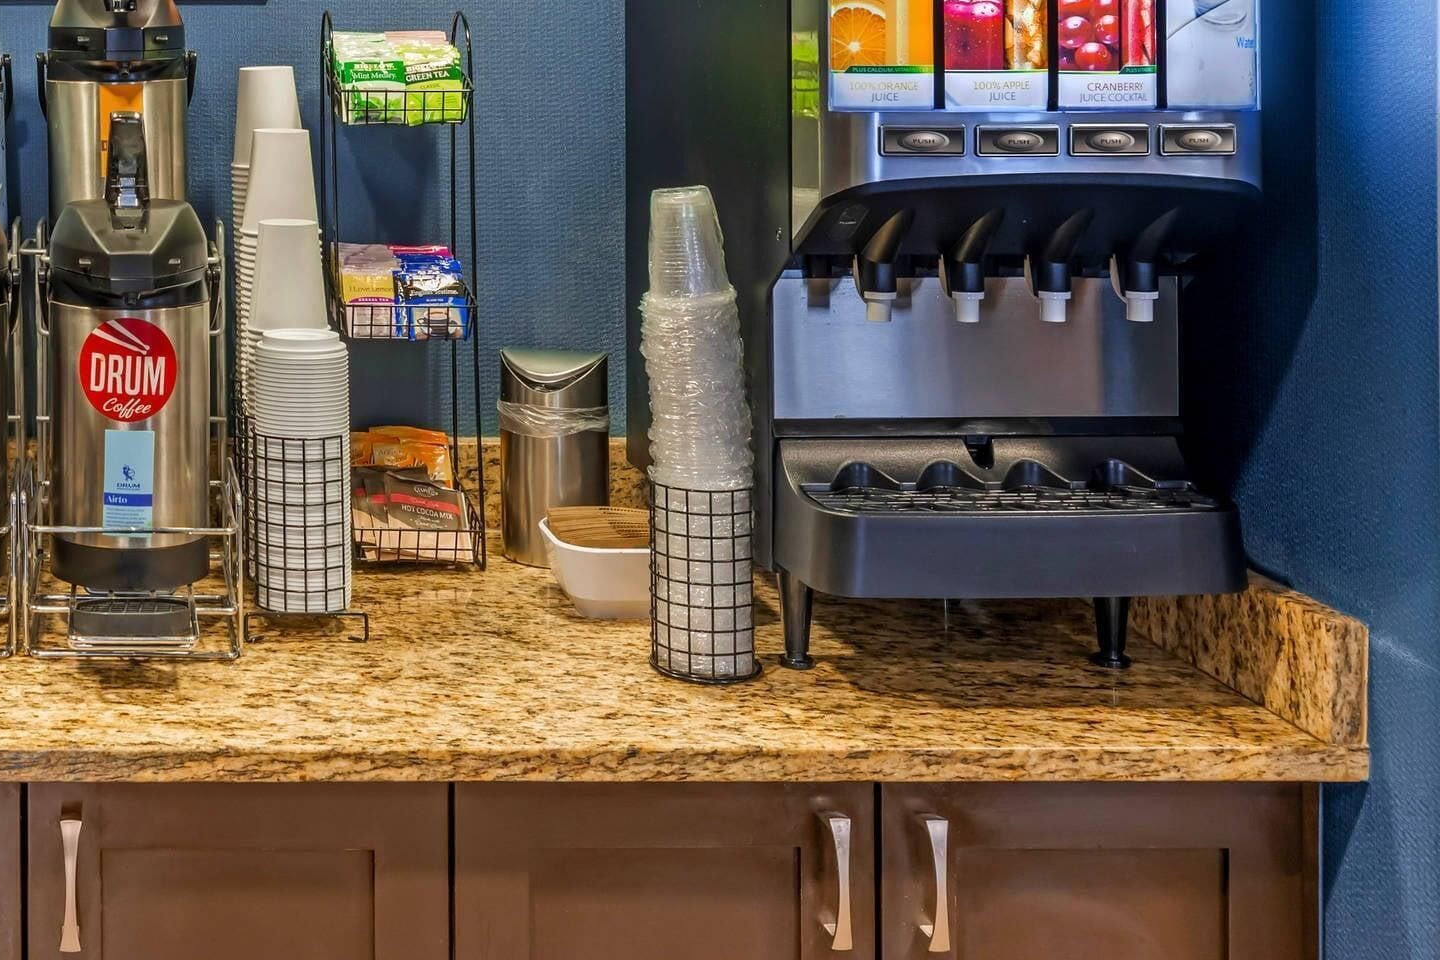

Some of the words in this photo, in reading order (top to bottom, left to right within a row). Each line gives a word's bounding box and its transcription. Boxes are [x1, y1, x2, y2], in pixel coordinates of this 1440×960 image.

[406, 71, 433, 82] GREEN
[434, 70, 450, 78] TEA
[878, 81, 919, 91] ORANGE
[973, 81, 1001, 91] 100%
[1002, 81, 1030, 90] APPLE
[1086, 82, 1144, 92] CRANBERRY
[871, 92, 899, 102] JUICE
[988, 91, 1017, 102] JUICE
[1079, 93, 1107, 103] JUICE
[90, 352, 166, 396] DRUM
[102, 397, 152, 419] Coffee
[401, 504, 415, 512] HOT
[416, 506, 439, 518] COCOA
